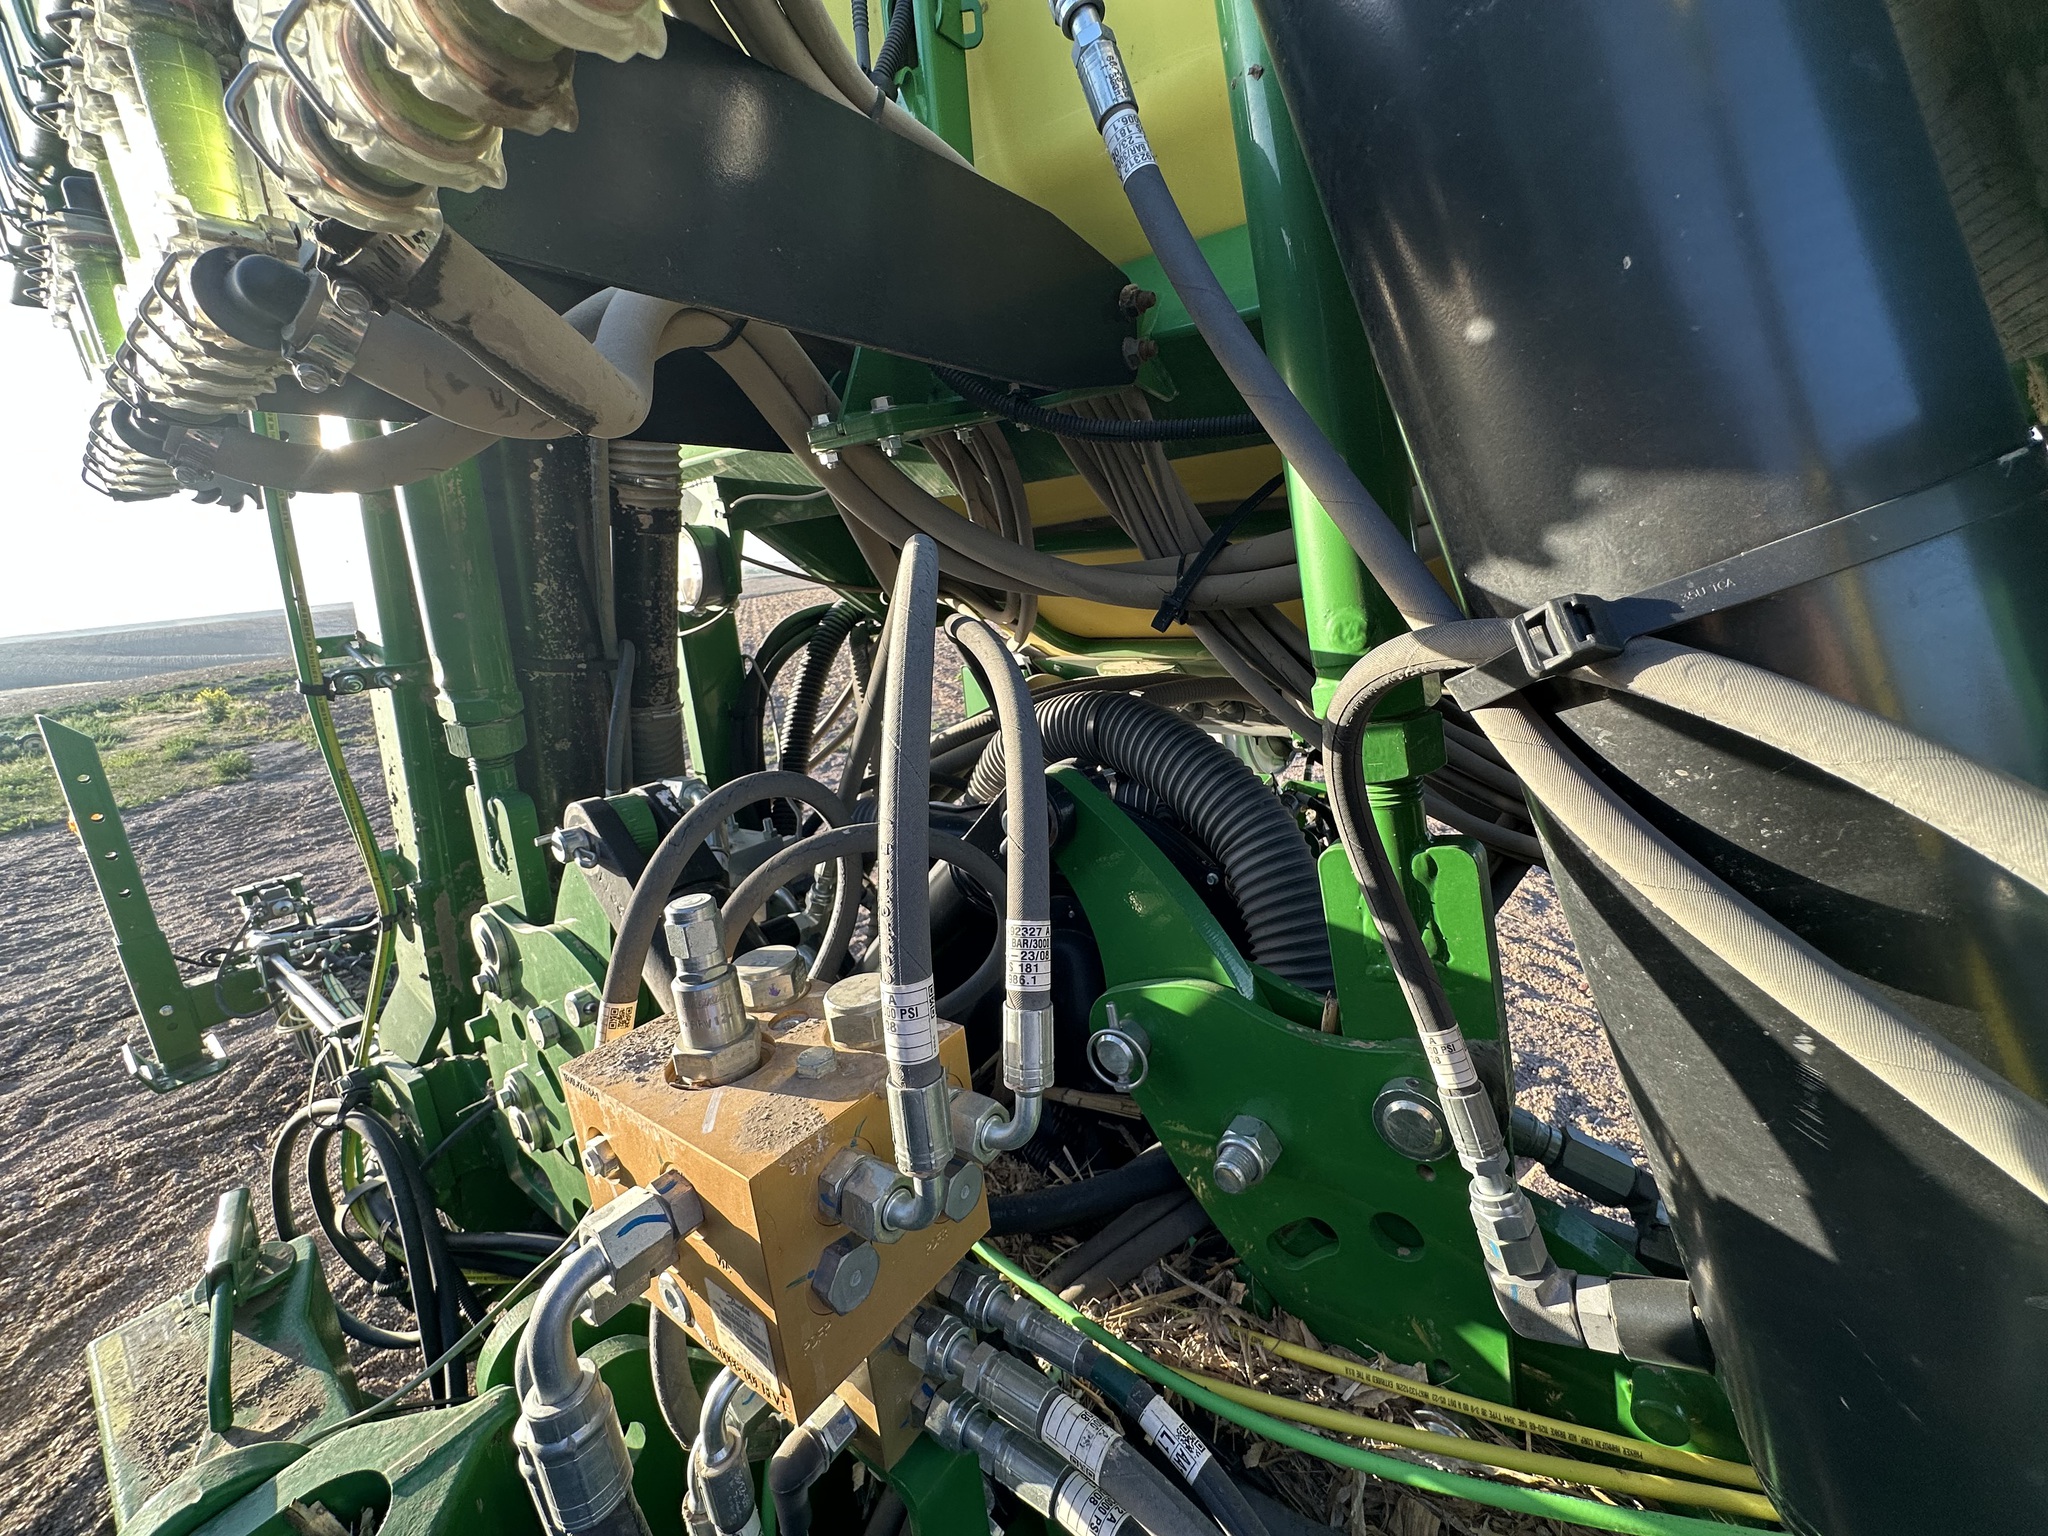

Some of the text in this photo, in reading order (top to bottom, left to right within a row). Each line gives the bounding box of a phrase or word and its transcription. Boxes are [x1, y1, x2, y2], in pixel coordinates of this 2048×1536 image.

[1115, 126, 1132, 142] 181
[1018, 963, 1039, 973] 181
[888, 995, 897, 1005] A
[900, 1006, 919, 1019] PSI
[1441, 1043, 1456, 1054] PSI
[1106, 1512, 1118, 1524] A
